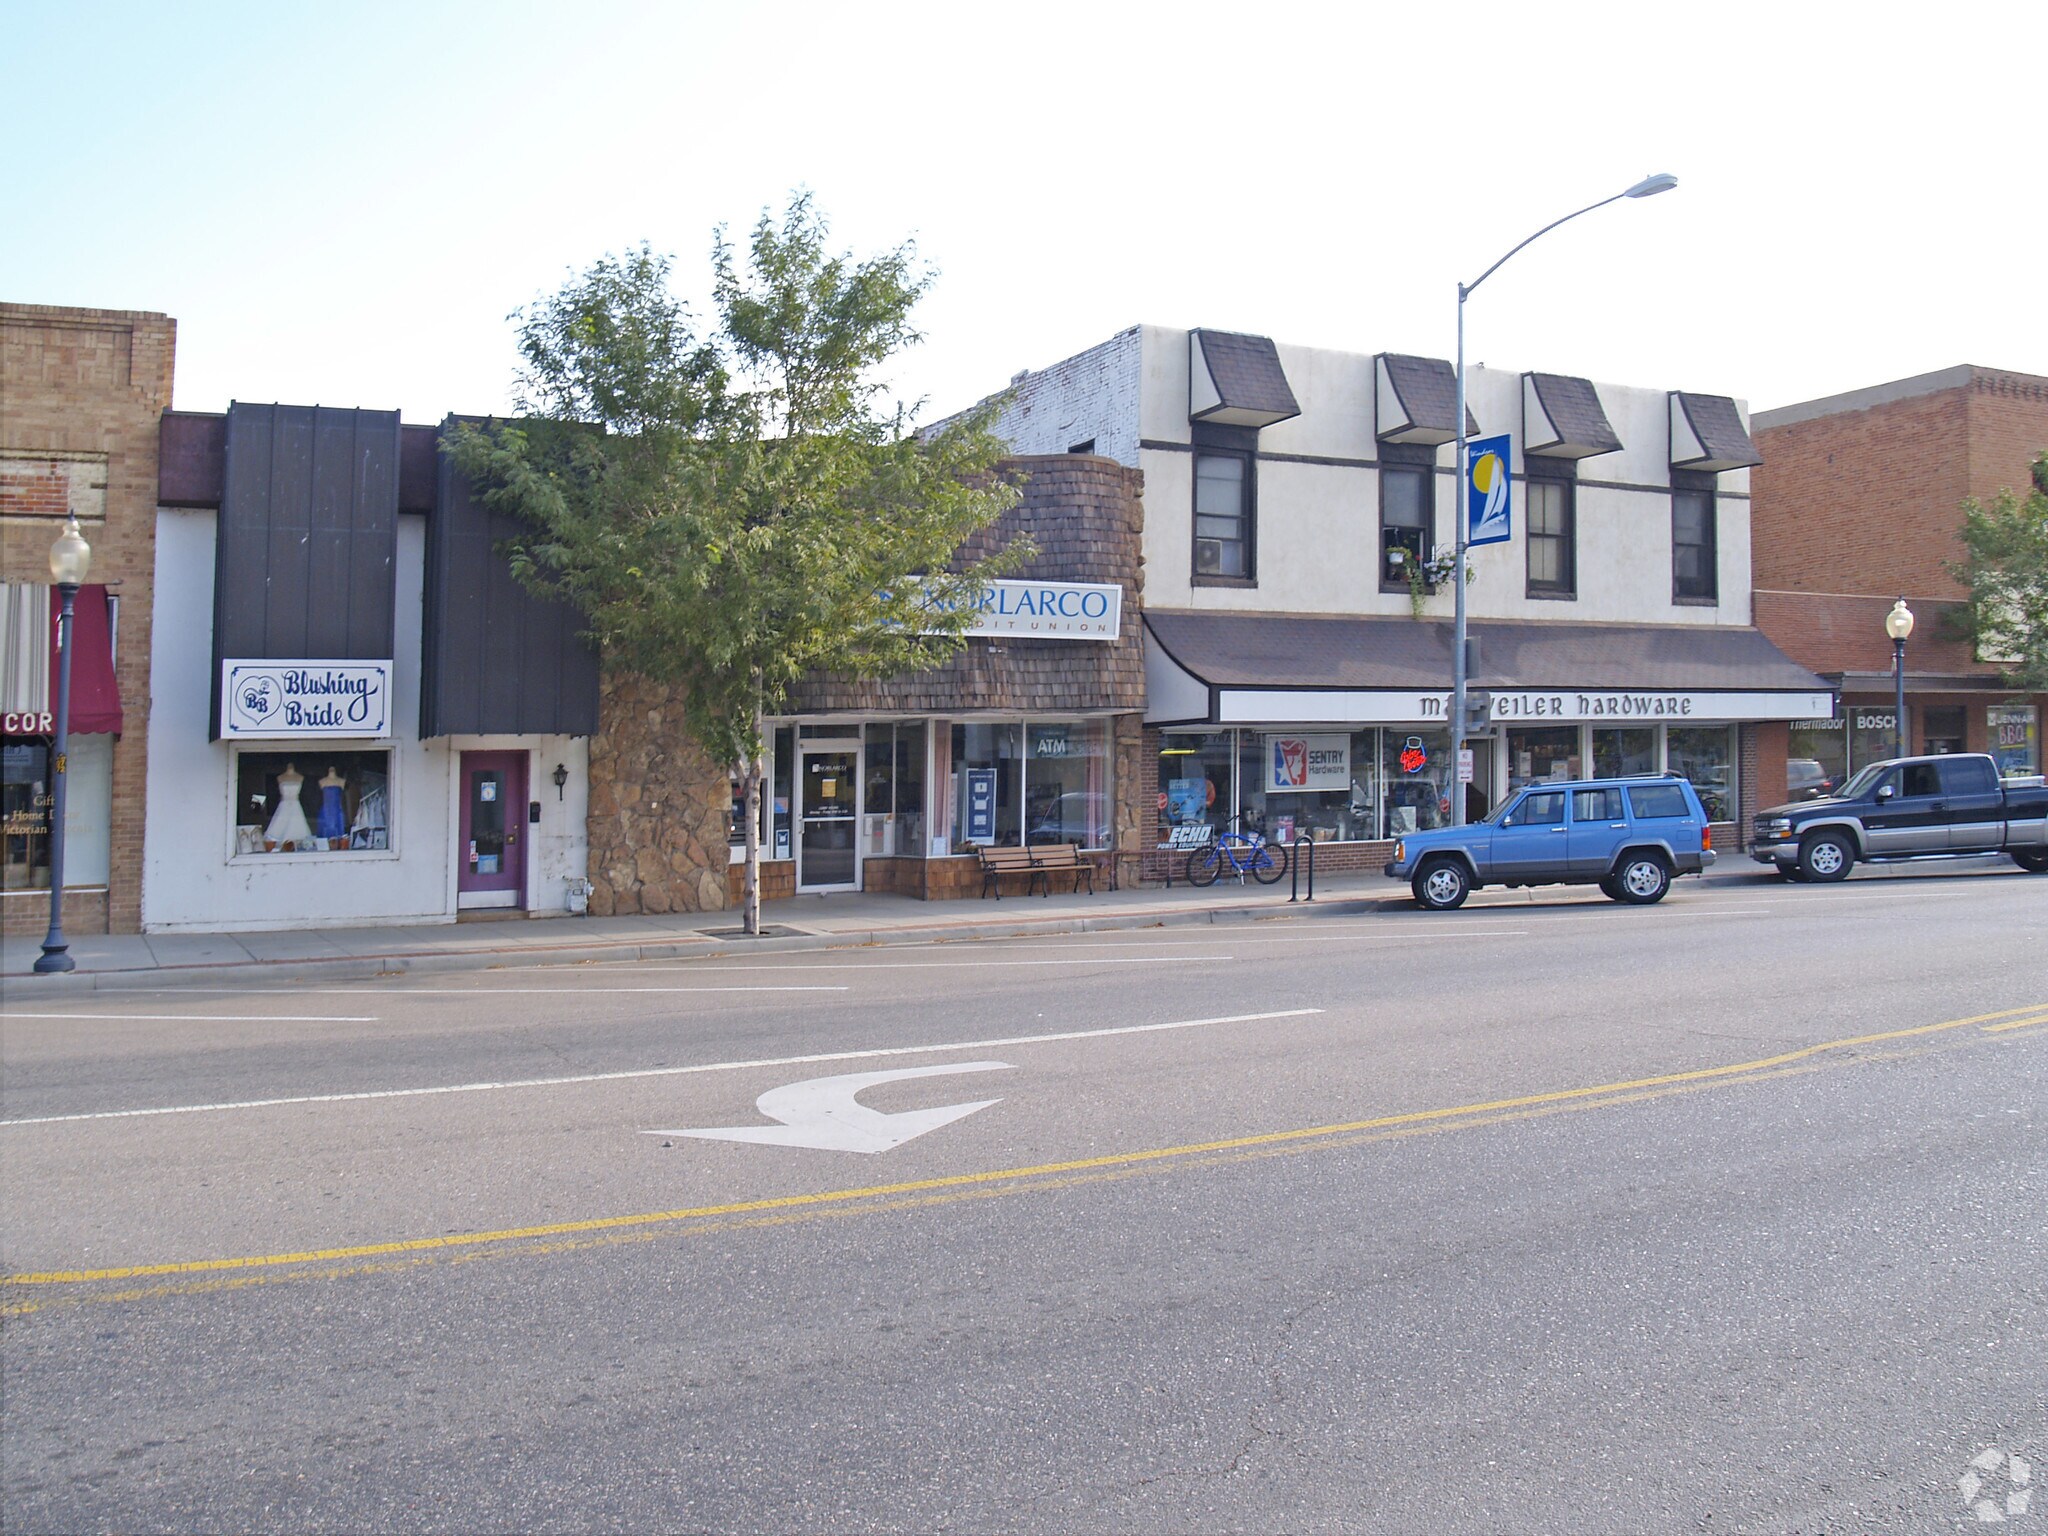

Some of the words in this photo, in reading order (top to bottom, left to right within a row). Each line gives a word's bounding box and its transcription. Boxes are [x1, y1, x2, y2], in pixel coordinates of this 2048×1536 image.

[1031, 621, 1106, 632] UNION
[281, 670, 378, 722] Blushing
[283, 701, 344, 726] Bride
[1038, 739, 1066, 753] ATM
[1309, 750, 1344, 764] SENTRY
[1309, 764, 1345, 775] Hardware
[11, 809, 45, 821] Home
[1169, 826, 1212, 842] ECHO
